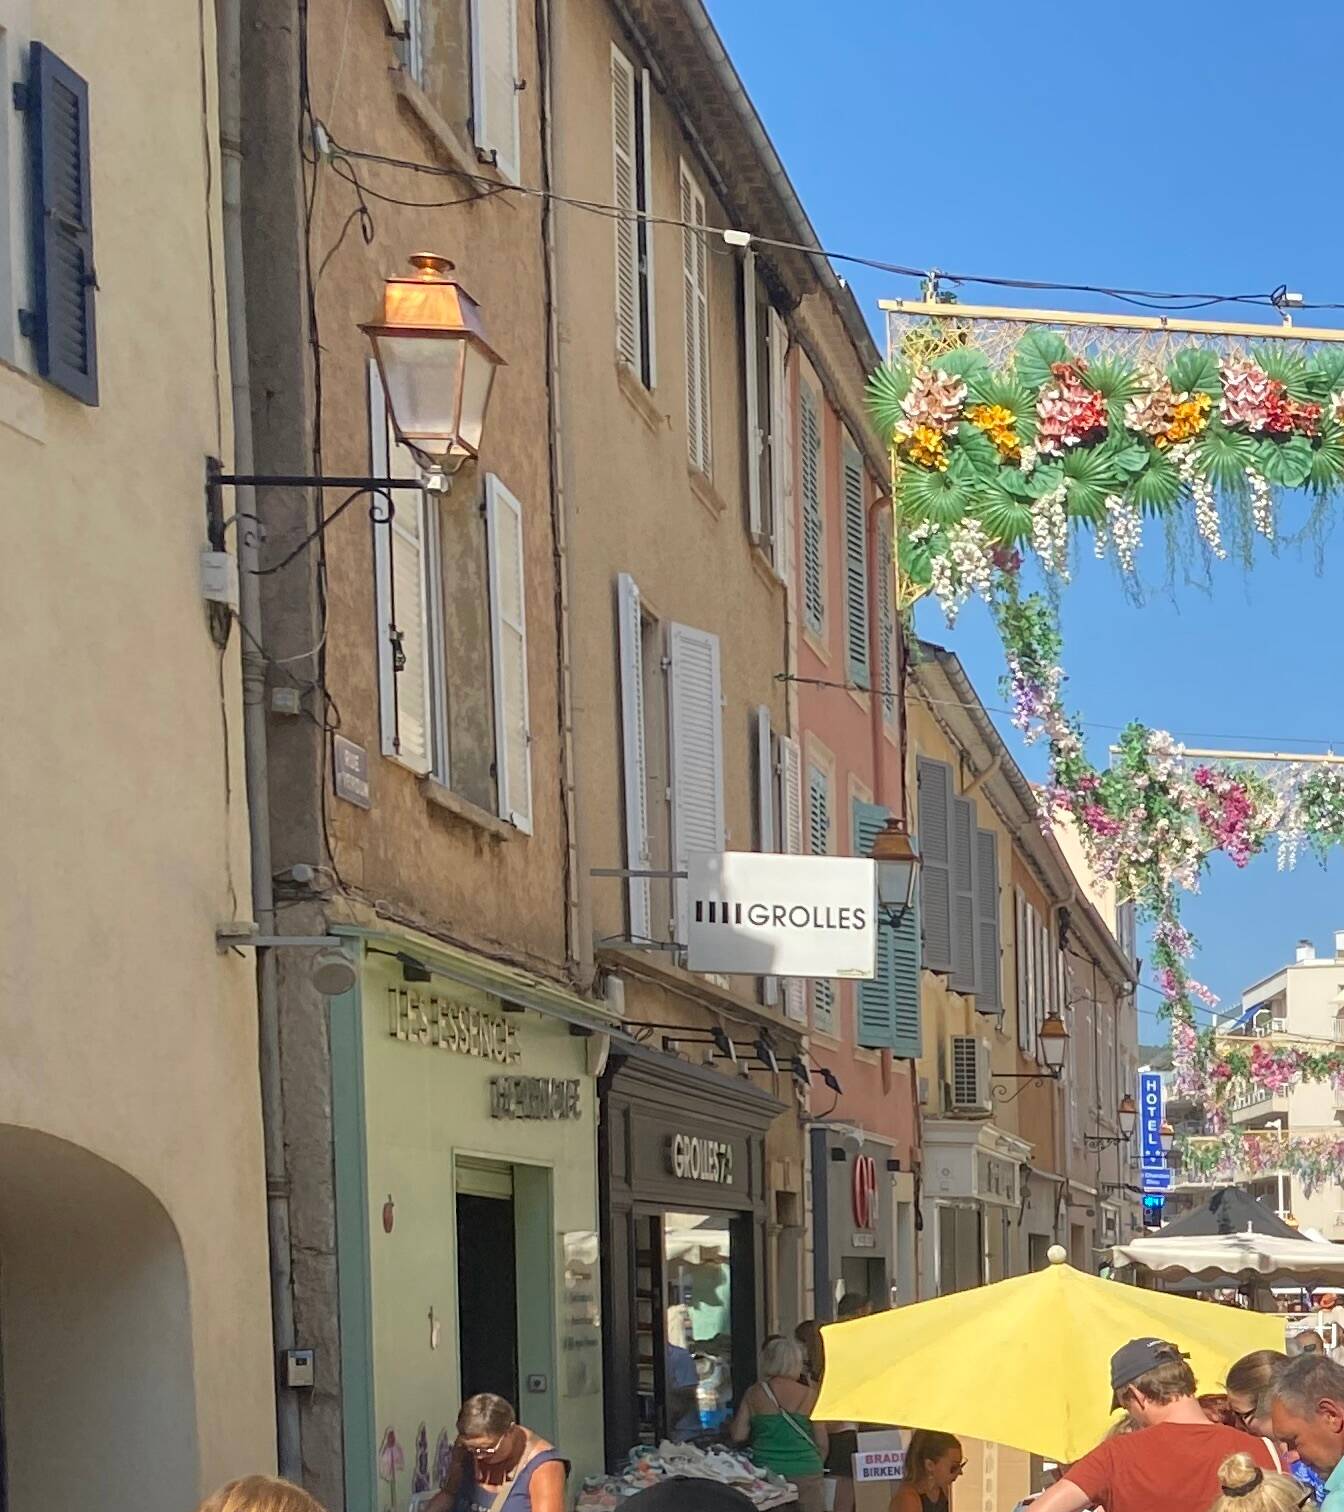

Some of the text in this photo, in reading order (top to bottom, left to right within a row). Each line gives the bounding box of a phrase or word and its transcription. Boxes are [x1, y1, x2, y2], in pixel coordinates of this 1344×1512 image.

[748, 904, 866, 930] GROLLES
[1146, 1080, 1157, 1145] HOTEL
[675, 1134, 719, 1182] GROLLES
[863, 1466, 901, 1478] BIRKEN
